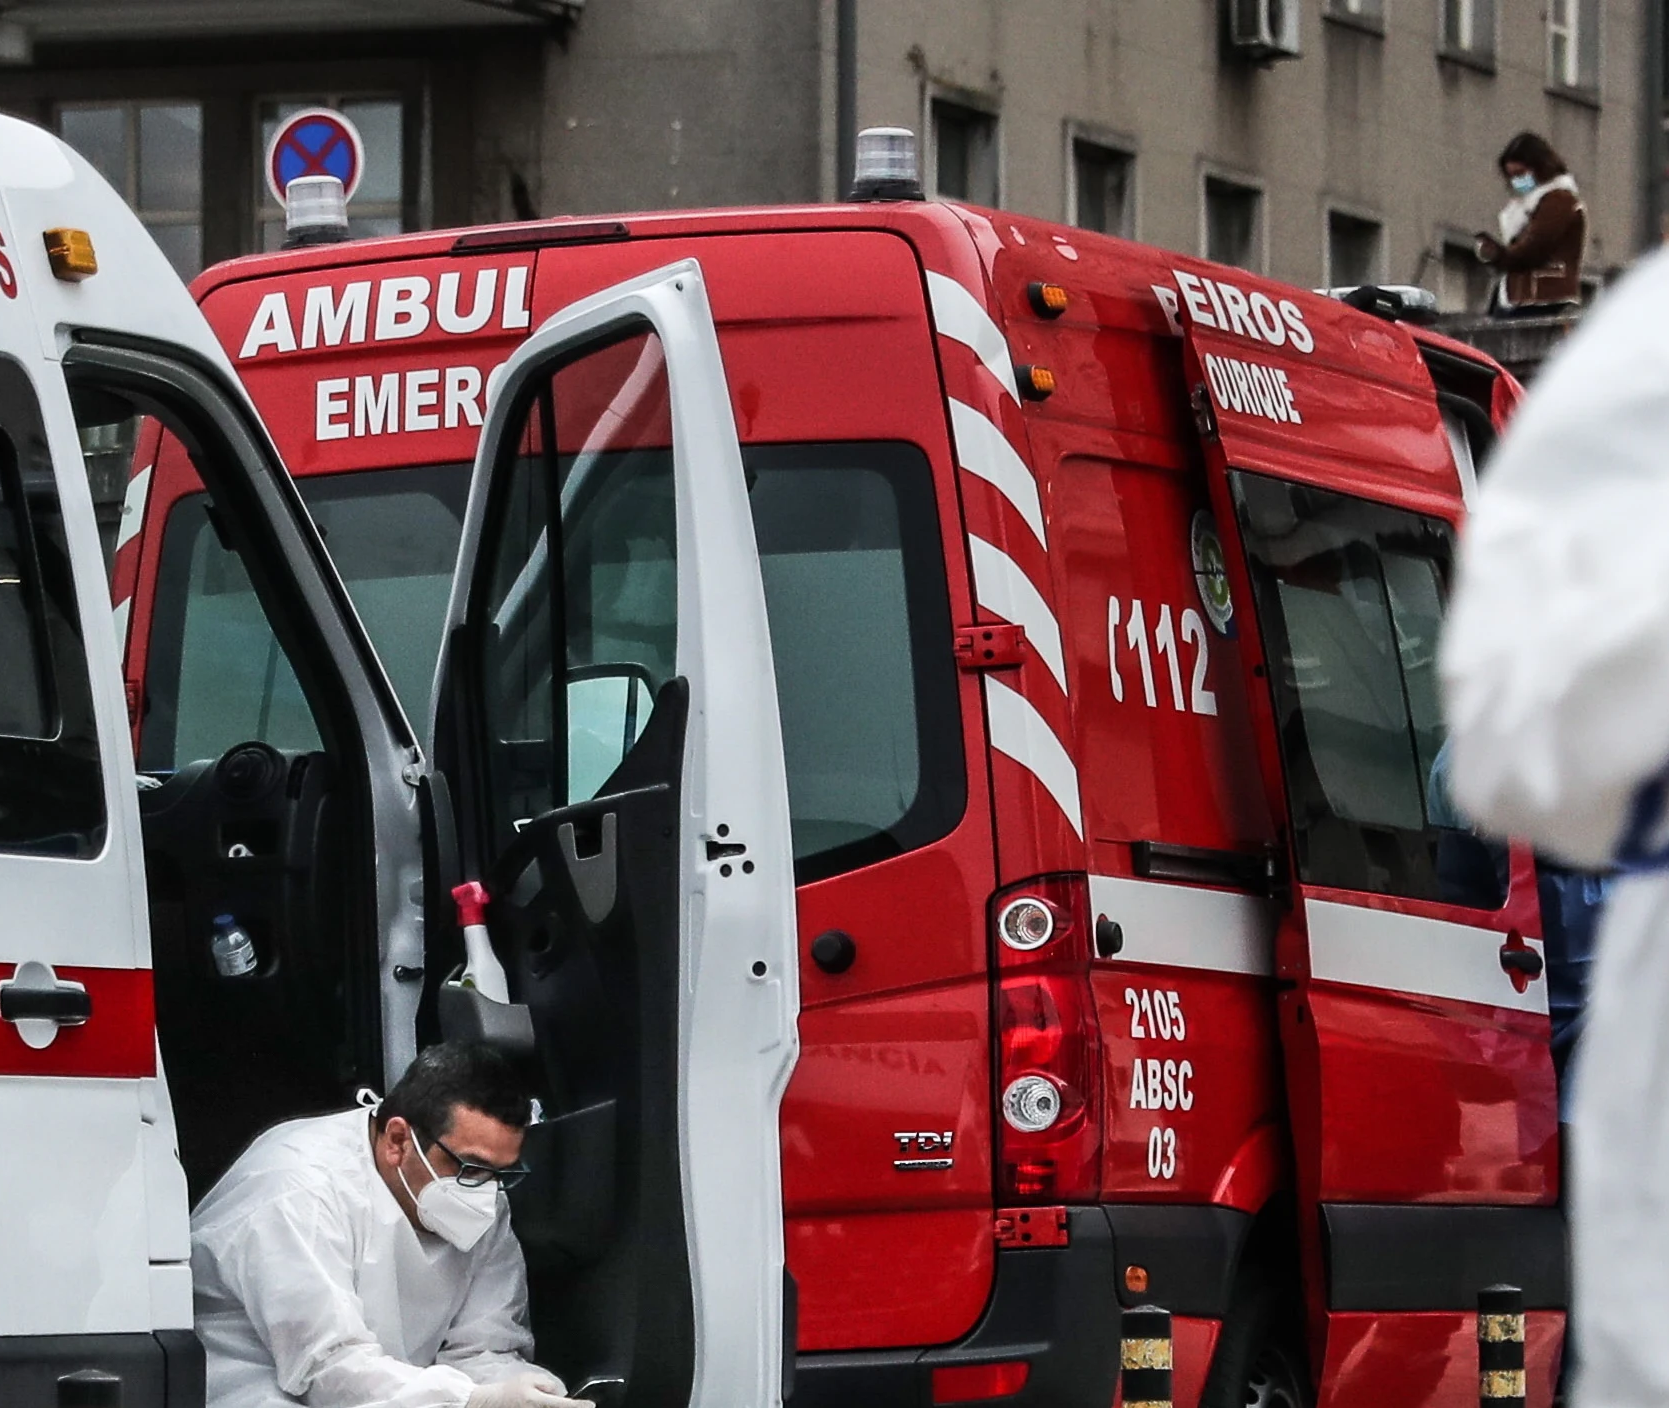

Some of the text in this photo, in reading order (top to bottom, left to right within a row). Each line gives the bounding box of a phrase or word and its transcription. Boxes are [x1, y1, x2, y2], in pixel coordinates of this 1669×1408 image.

[1204, 352, 1303, 426] OURIQUE
[1127, 598, 1218, 717] 112
[1125, 987, 1185, 1041] 2105
[1129, 1058, 1194, 1111] ABSC
[894, 1131, 953, 1152] TDI
[1148, 1126, 1176, 1179] 03
